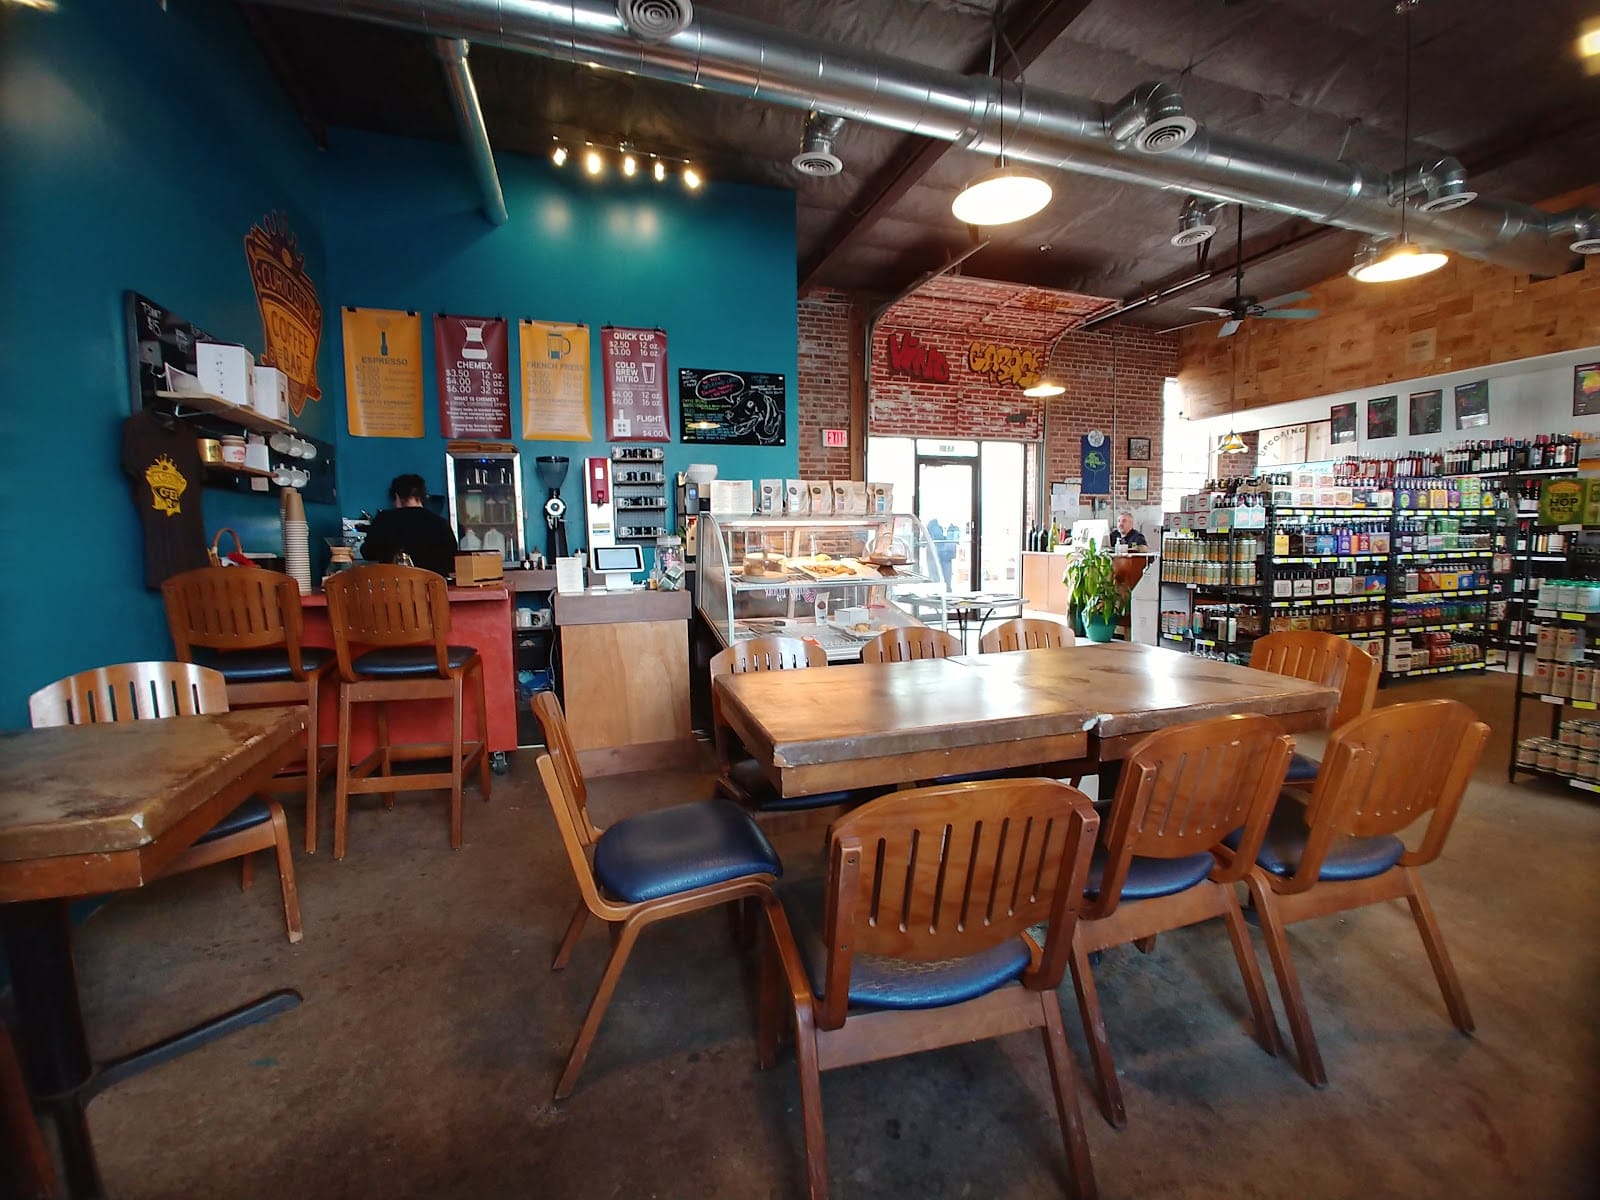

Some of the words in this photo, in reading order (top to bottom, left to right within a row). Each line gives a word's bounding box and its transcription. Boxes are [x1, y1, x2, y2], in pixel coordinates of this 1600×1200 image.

[271, 311, 310, 360] COFFEE
[614, 332, 637, 340] QUICK
[609, 340, 630, 350] $2.50
[609, 348, 631, 356] $3.00
[283, 348, 304, 381] BAR
[362, 356, 408, 366] ESPRESSO
[457, 360, 492, 370] CHEMEX
[526, 361, 558, 369] FRENCH
[560, 363, 585, 372] PRESS
[446, 368, 470, 378] $3.50
[480, 371, 490, 379] 12
[446, 377, 470, 386] $4.00
[482, 379, 490, 388] 16
[446, 386, 471, 394] $6.00
[612, 390, 633, 398] $4.00
[1550, 498, 1578, 506] HOP
